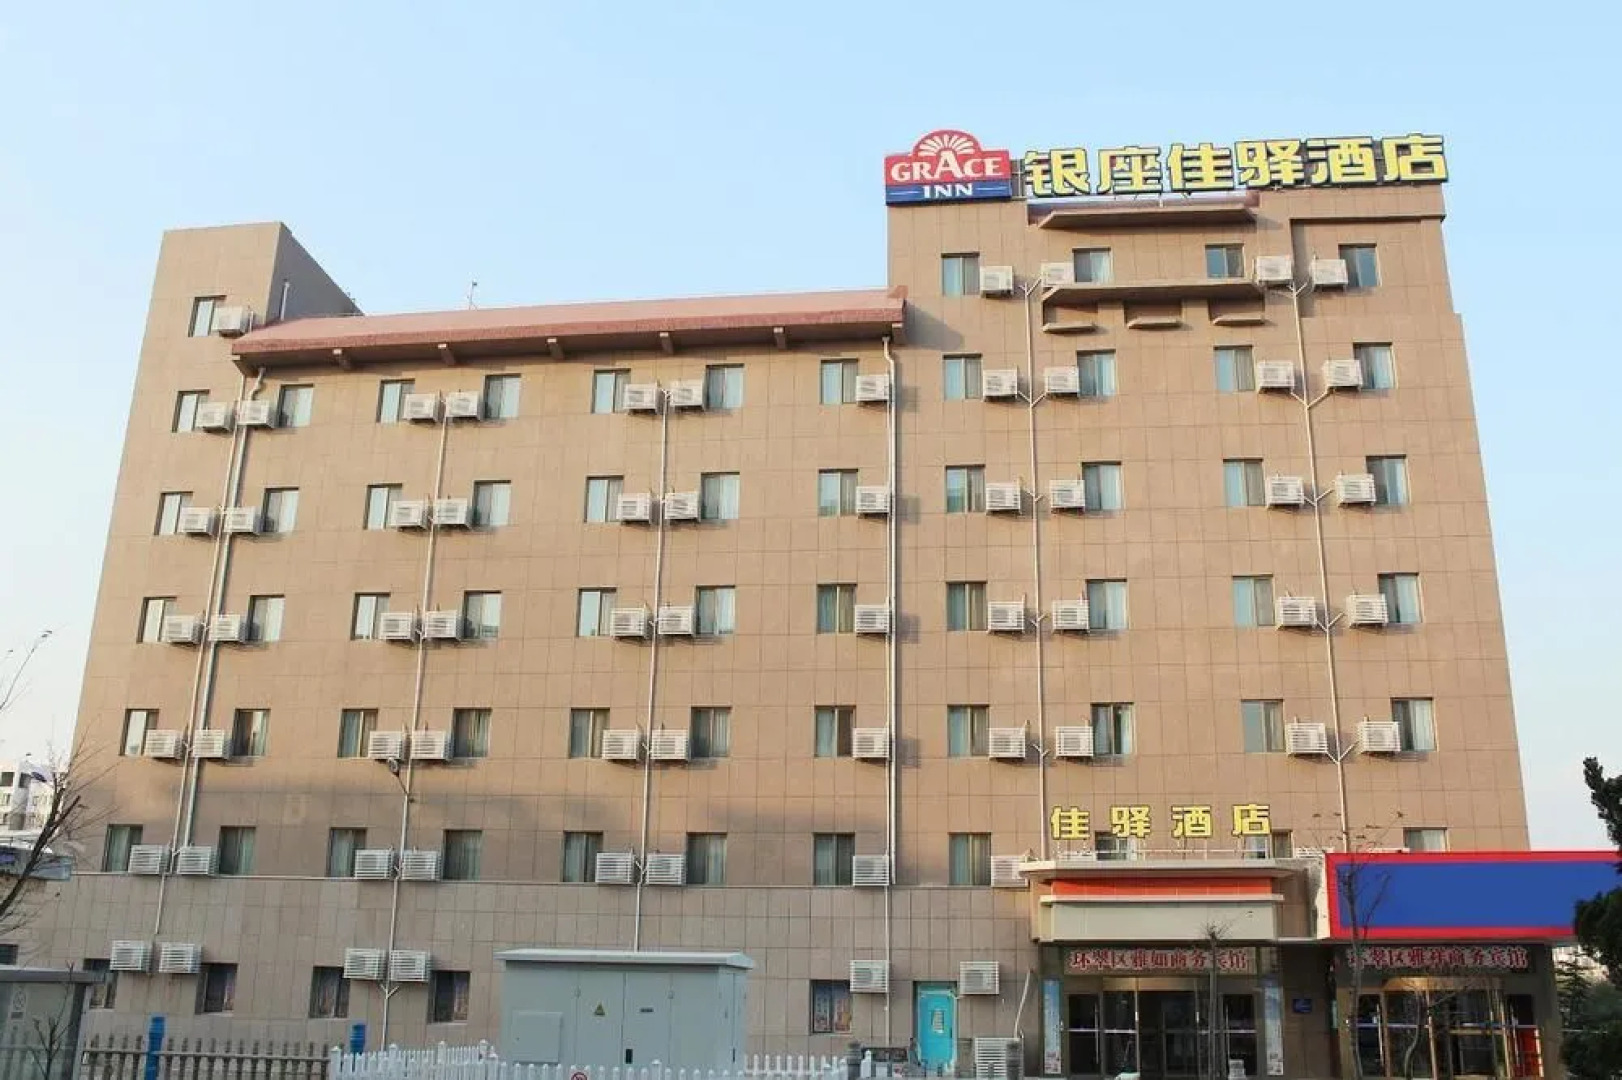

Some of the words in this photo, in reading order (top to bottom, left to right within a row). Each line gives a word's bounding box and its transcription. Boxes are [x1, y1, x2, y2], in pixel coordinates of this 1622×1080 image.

[891, 149, 1004, 182] GRACE
[1024, 133, 1449, 197] 银座佳驿酒店
[921, 182, 974, 199] INN
[1050, 803, 1271, 840] 佳驿酒店
